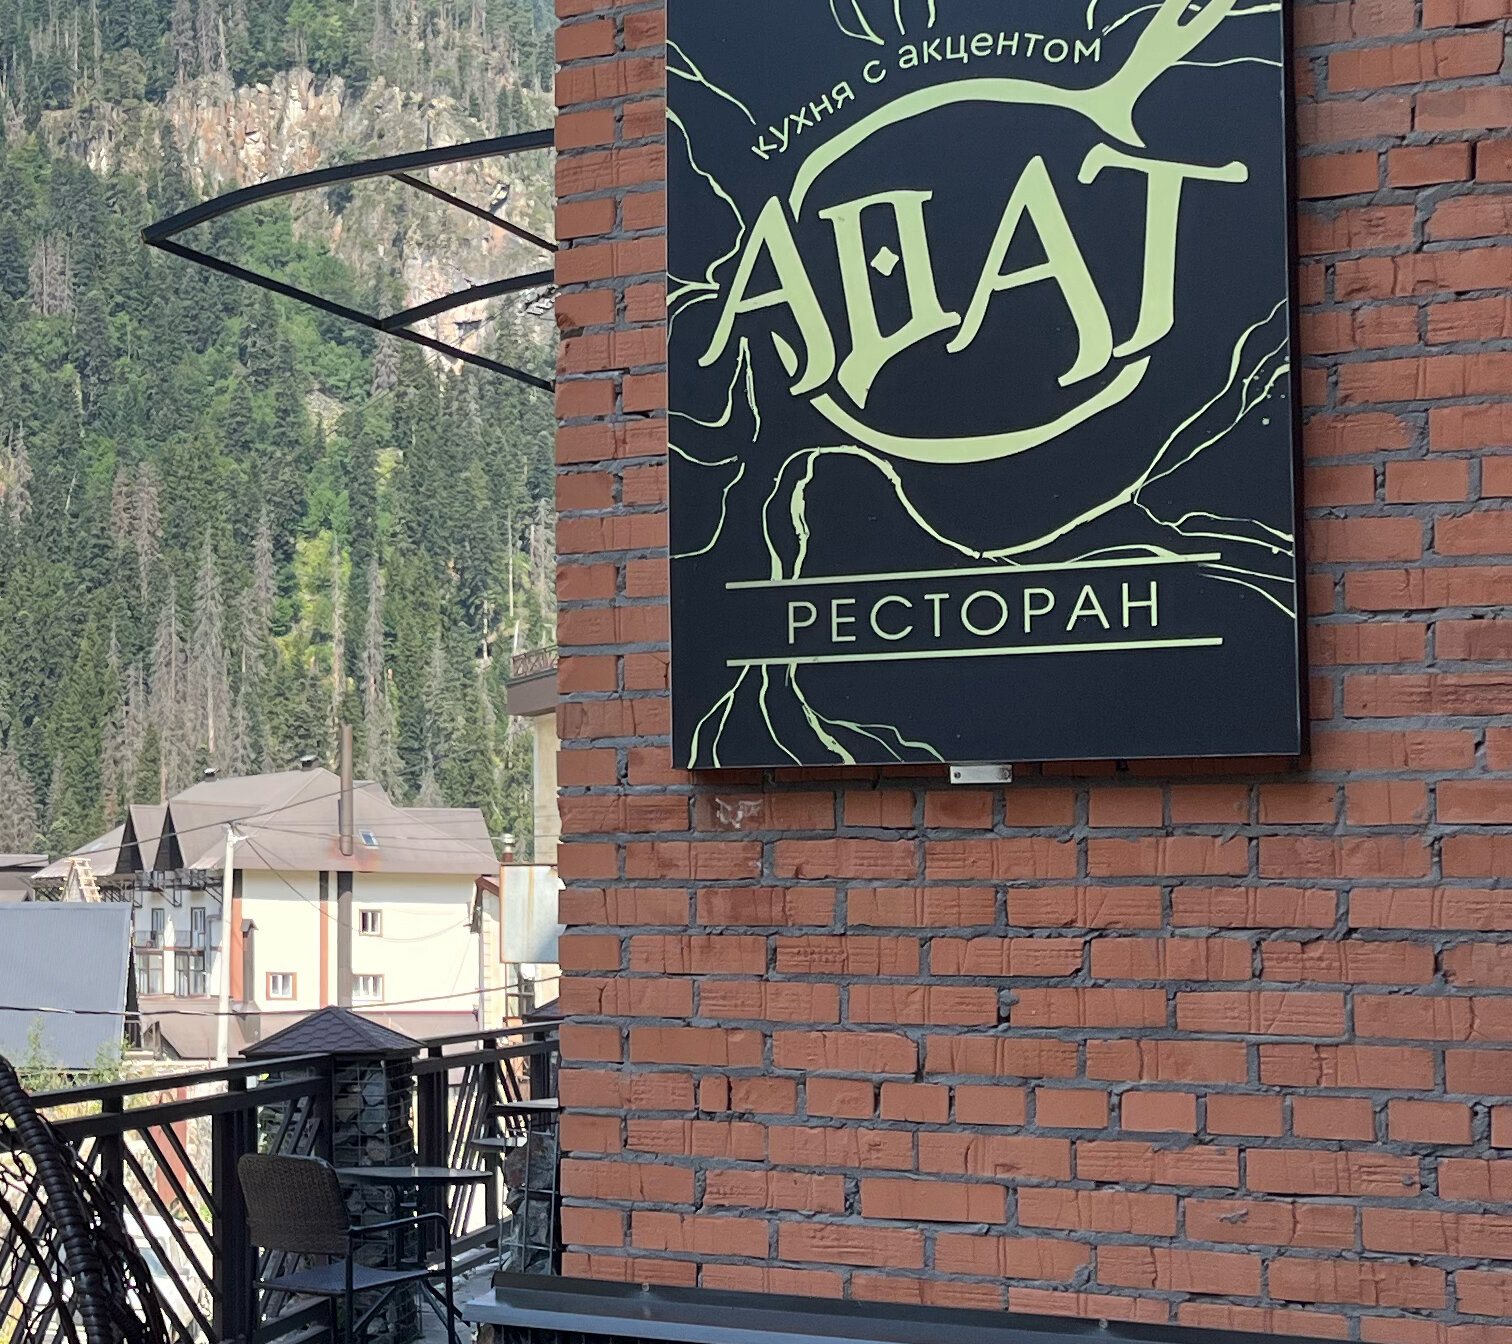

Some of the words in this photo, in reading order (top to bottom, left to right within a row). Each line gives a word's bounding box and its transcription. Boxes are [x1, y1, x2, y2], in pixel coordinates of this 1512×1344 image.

[751, 81, 855, 160] кухня
[862, 60, 887, 84] с
[898, 31, 1102, 69] акцентом
[698, 142, 1249, 410] АДАТ
[787, 581, 1158, 645] РЕСТОРАН
